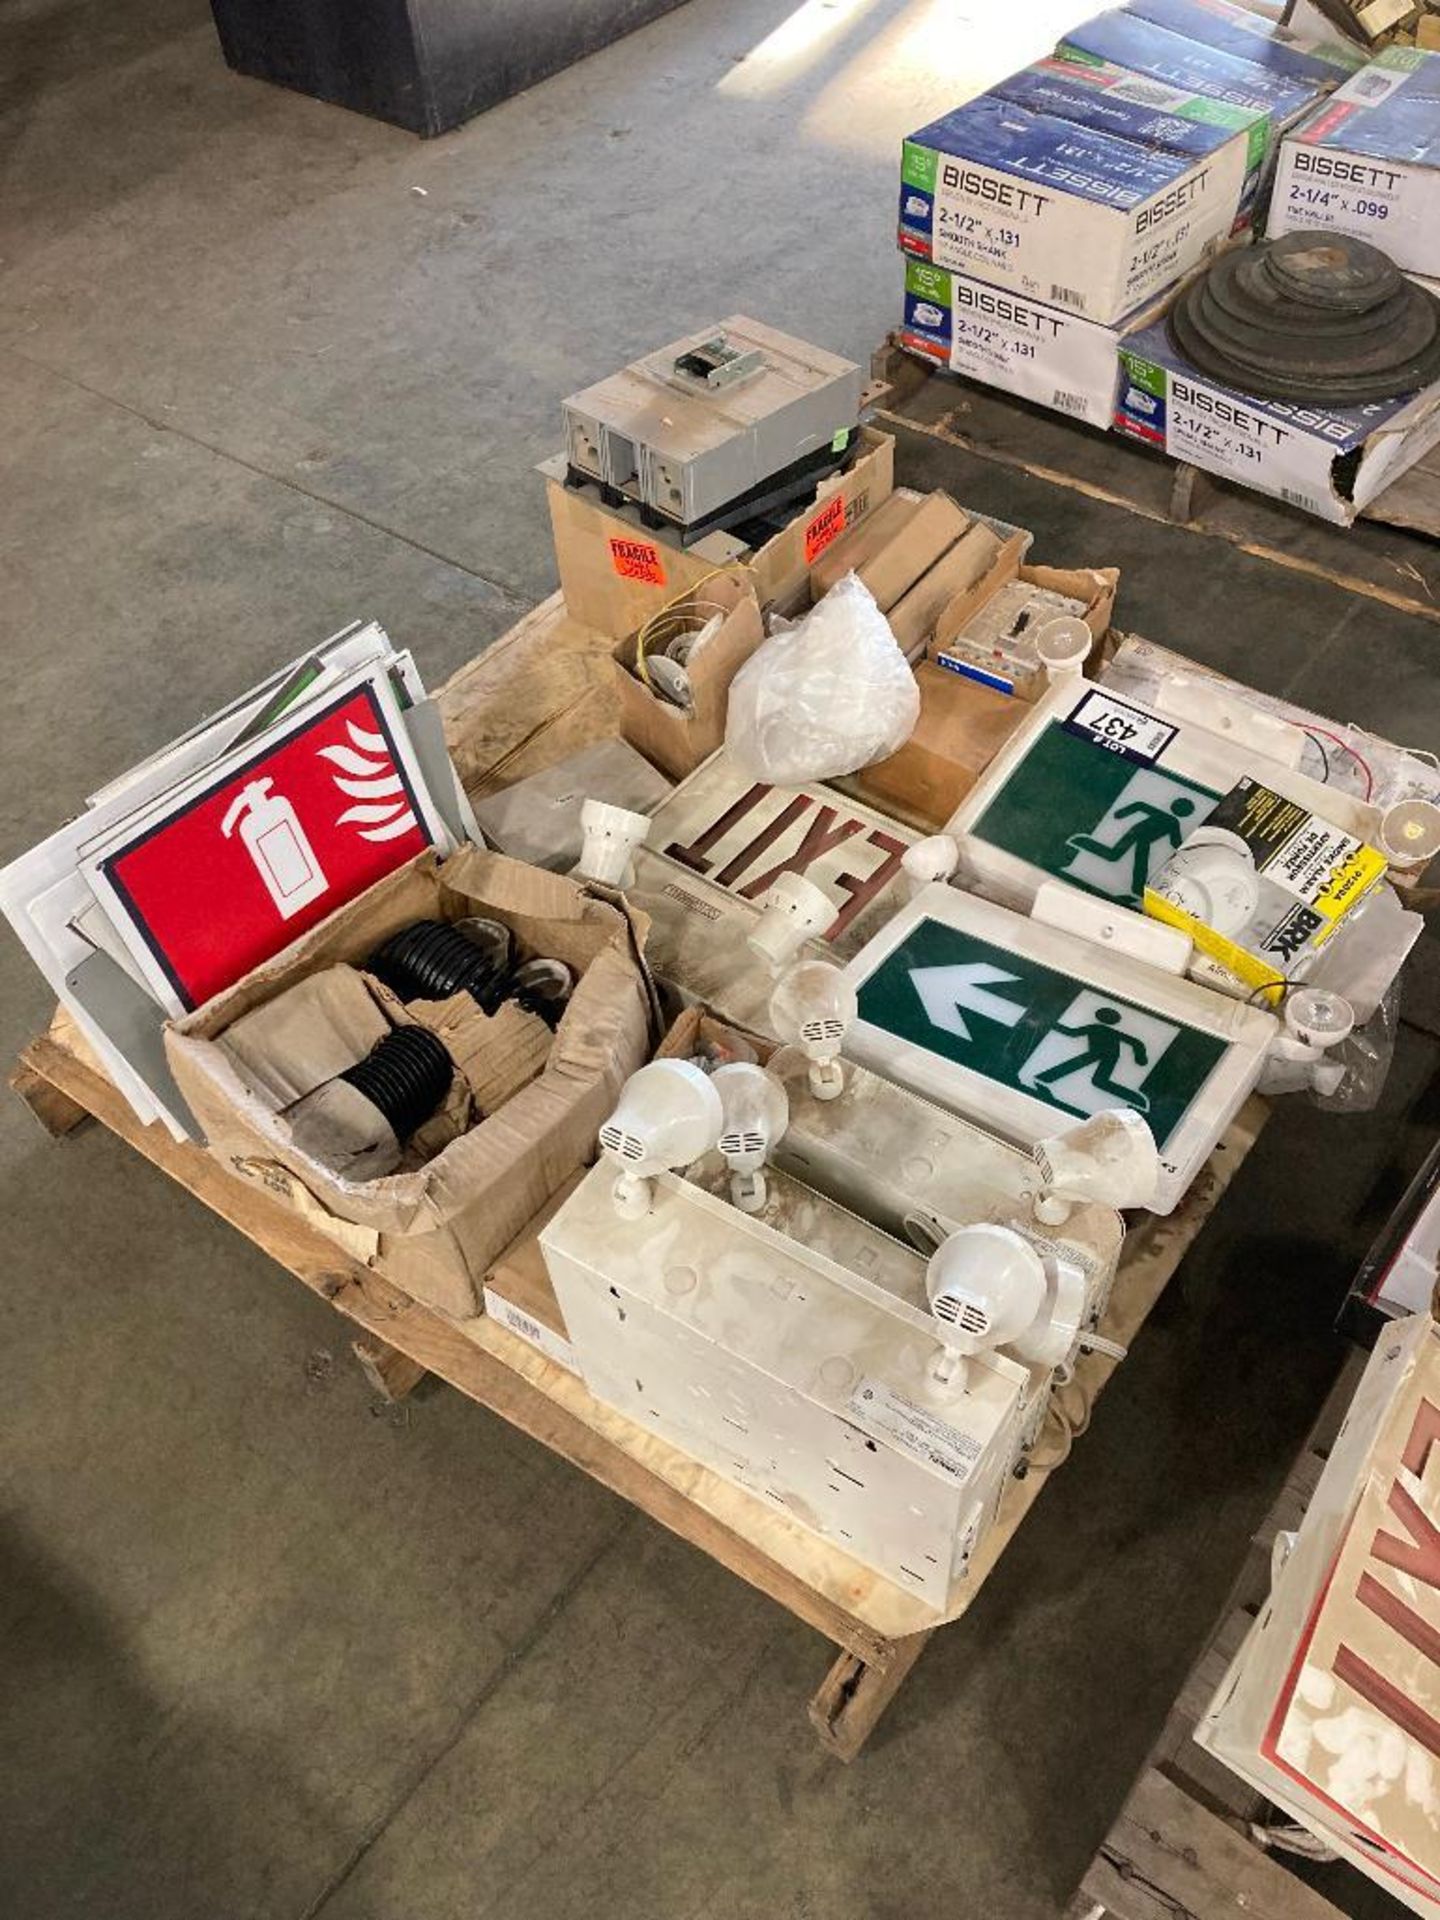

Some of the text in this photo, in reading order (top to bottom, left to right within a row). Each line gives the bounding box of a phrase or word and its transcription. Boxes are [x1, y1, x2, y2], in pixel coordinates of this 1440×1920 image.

[942, 164, 1049, 217] BISSETT
[1005, 156, 1142, 204] BISSETT
[1294, 151, 1402, 190] BISSETT
[1136, 169, 1209, 235] BISSETT
[1289, 184, 1340, 207] 2-1/4"
[1352, 200, 1388, 220] .099
[939, 207, 982, 233] 2-1/2"
[995, 228, 1020, 248] .131
[957, 285, 1064, 337] BISSETT
[957, 320, 999, 343] 2-1/2"
[1010, 341, 1035, 359] .131
[1171, 380, 1289, 445] BISSETT
[1173, 411, 1220, 442] 2-1/2"
[1235, 441, 1263, 463] .131
[805, 499, 843, 546] FRAGILE
[1089, 713, 1138, 740] 437
[1102, 738, 1127, 754] LOT
[1268, 907, 1323, 963] BRK
